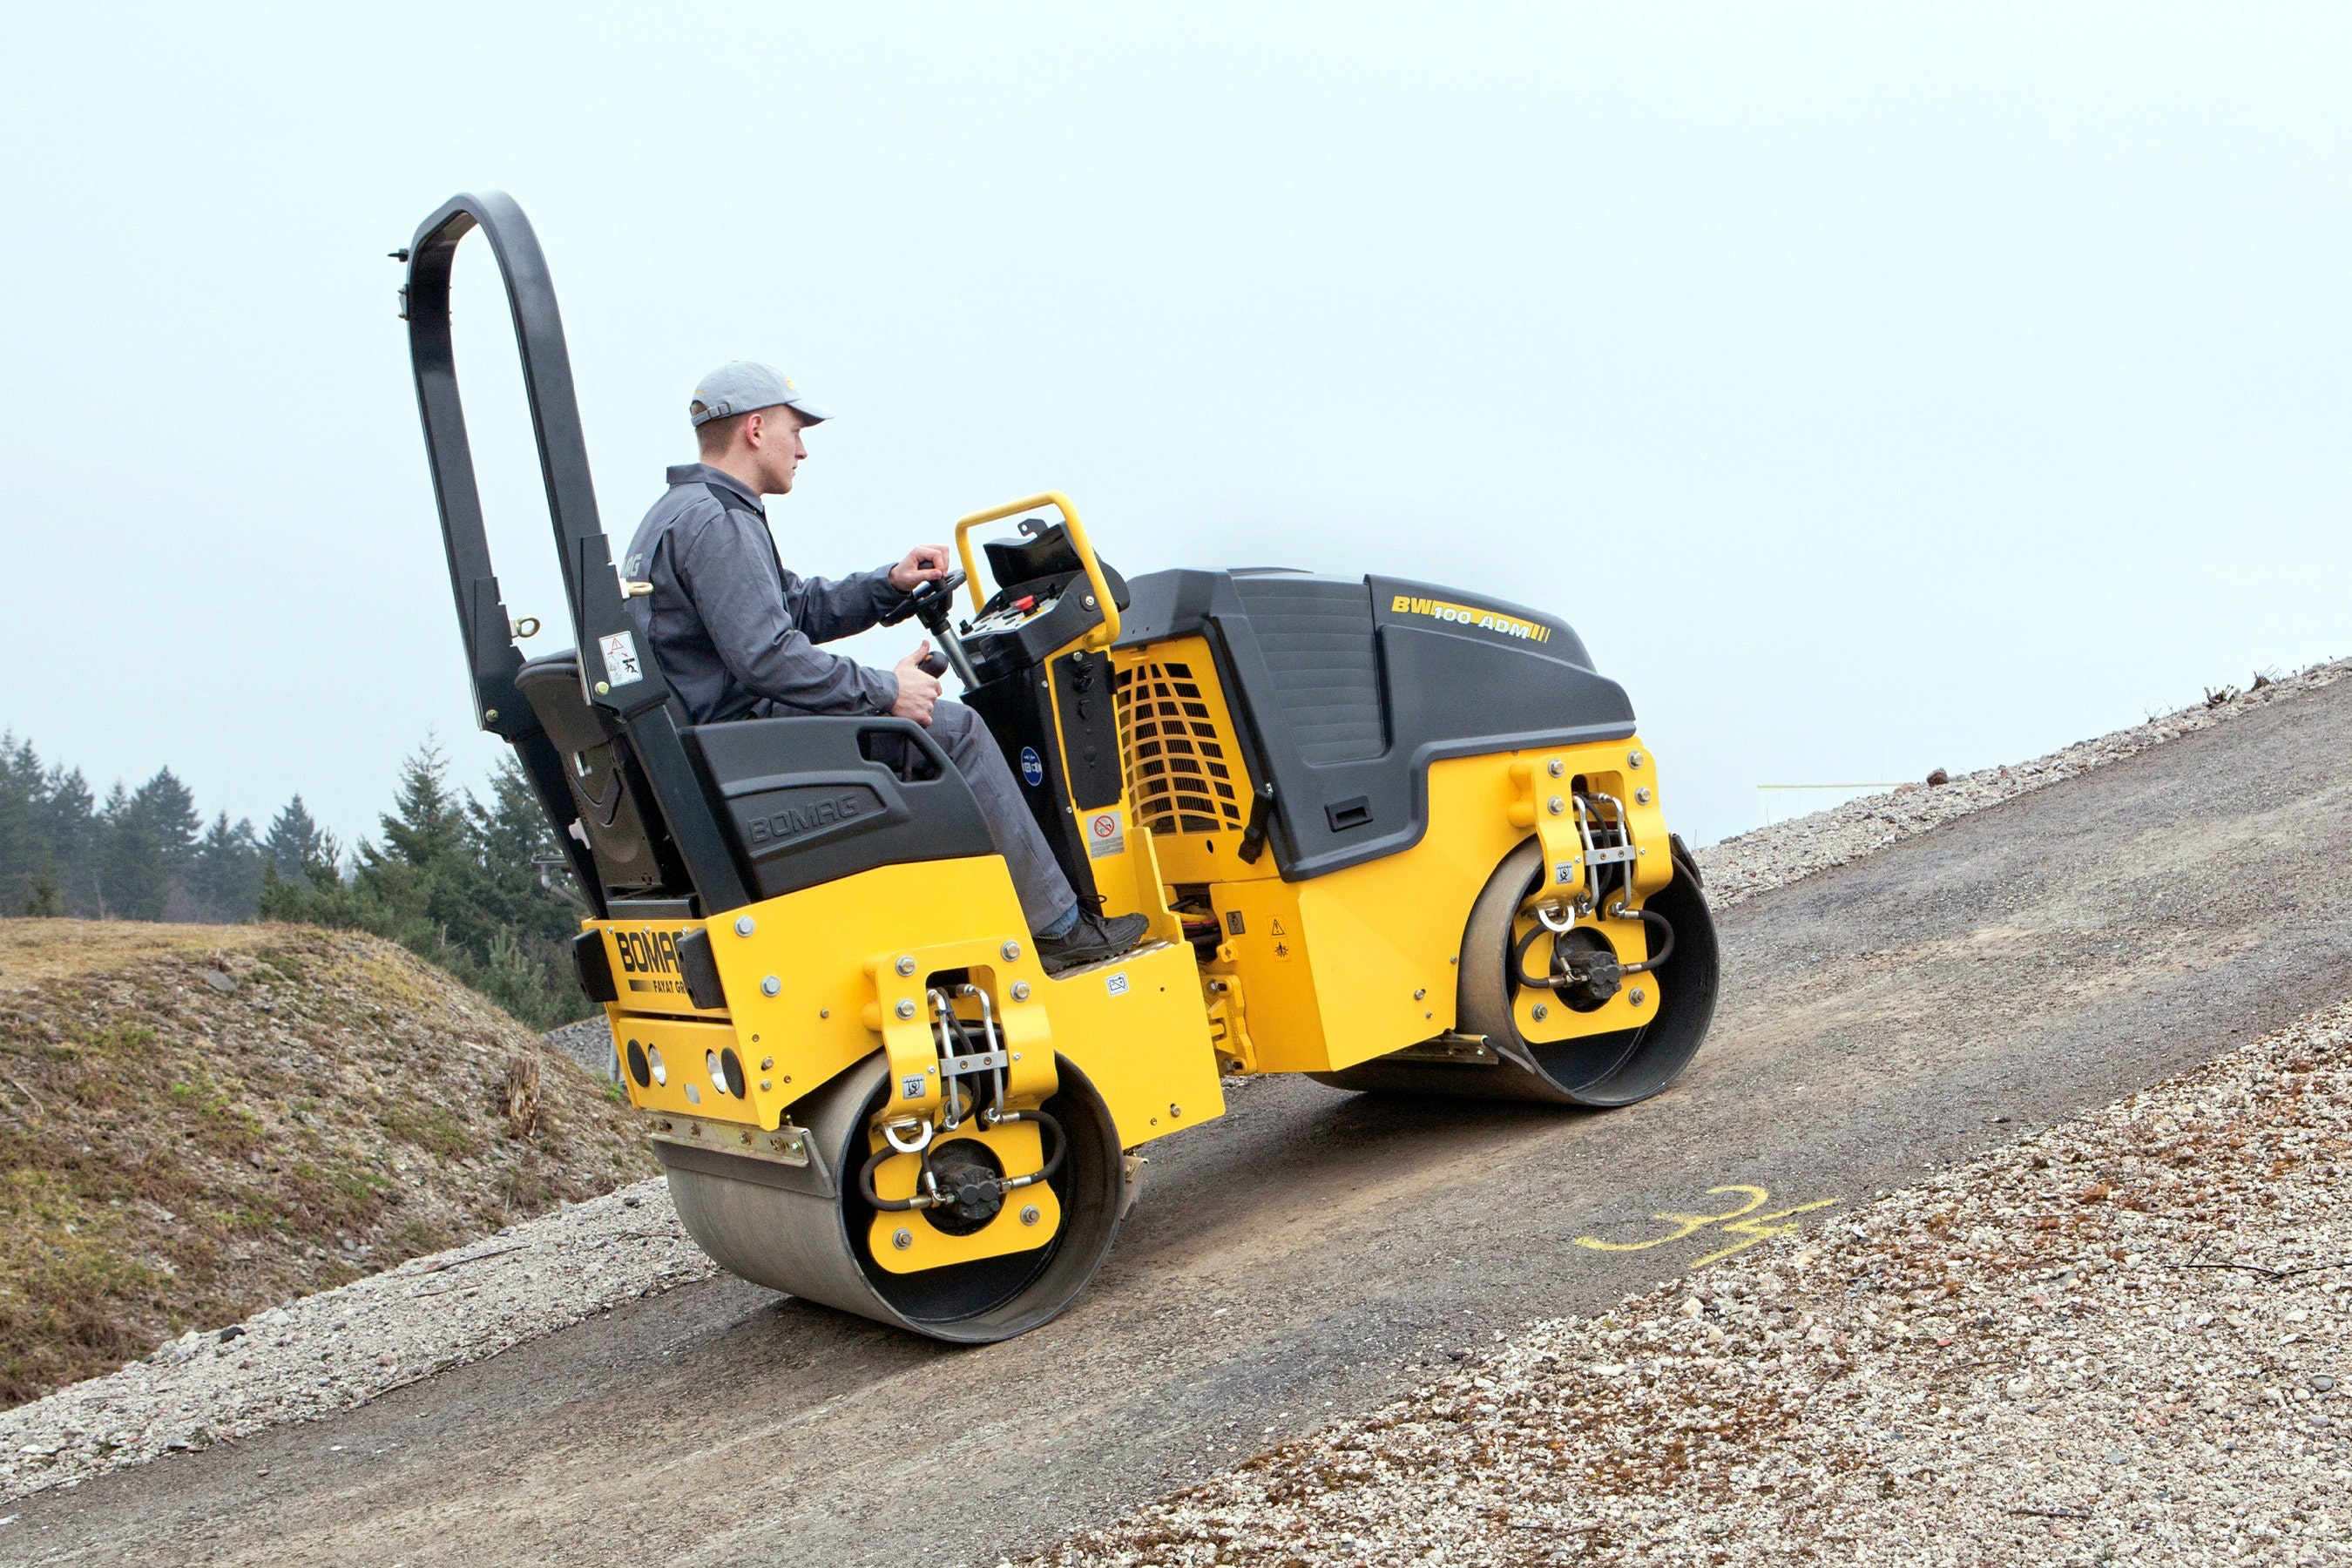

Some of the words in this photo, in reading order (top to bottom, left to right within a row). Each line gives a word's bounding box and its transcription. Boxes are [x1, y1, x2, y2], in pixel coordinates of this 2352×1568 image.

[1391, 595, 1435, 615] BW
[1433, 606, 1472, 625] 100
[1478, 616, 1530, 639] ADM
[747, 793, 861, 843] BOMAG
[615, 931, 684, 974] BOMA
[653, 980, 674, 993] FAYAT
